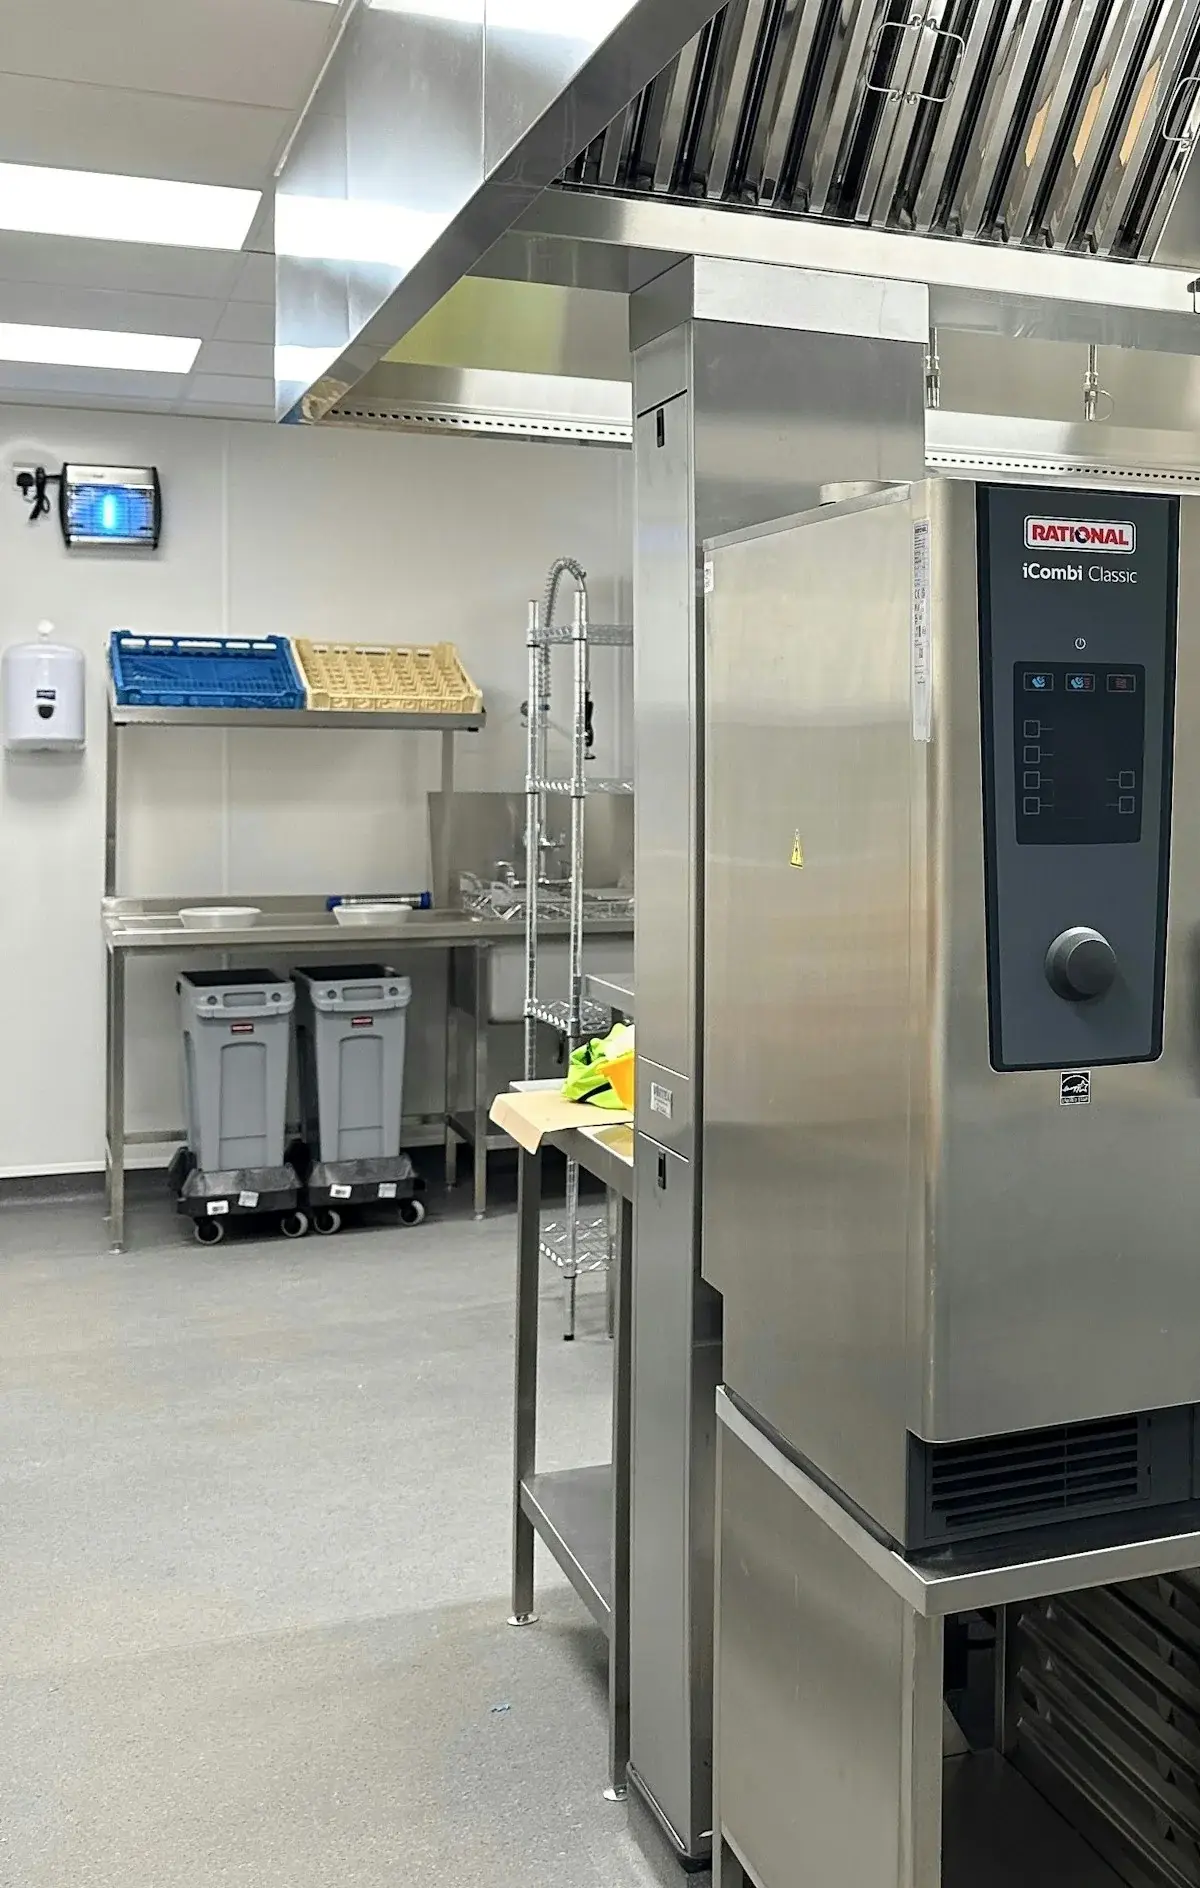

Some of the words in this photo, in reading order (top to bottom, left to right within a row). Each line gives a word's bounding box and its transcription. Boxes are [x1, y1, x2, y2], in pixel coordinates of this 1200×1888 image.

[1032, 524, 1129, 546] RATIONAL
[1022, 562, 1083, 581] iCombi
[1088, 565, 1137, 584] Classic
